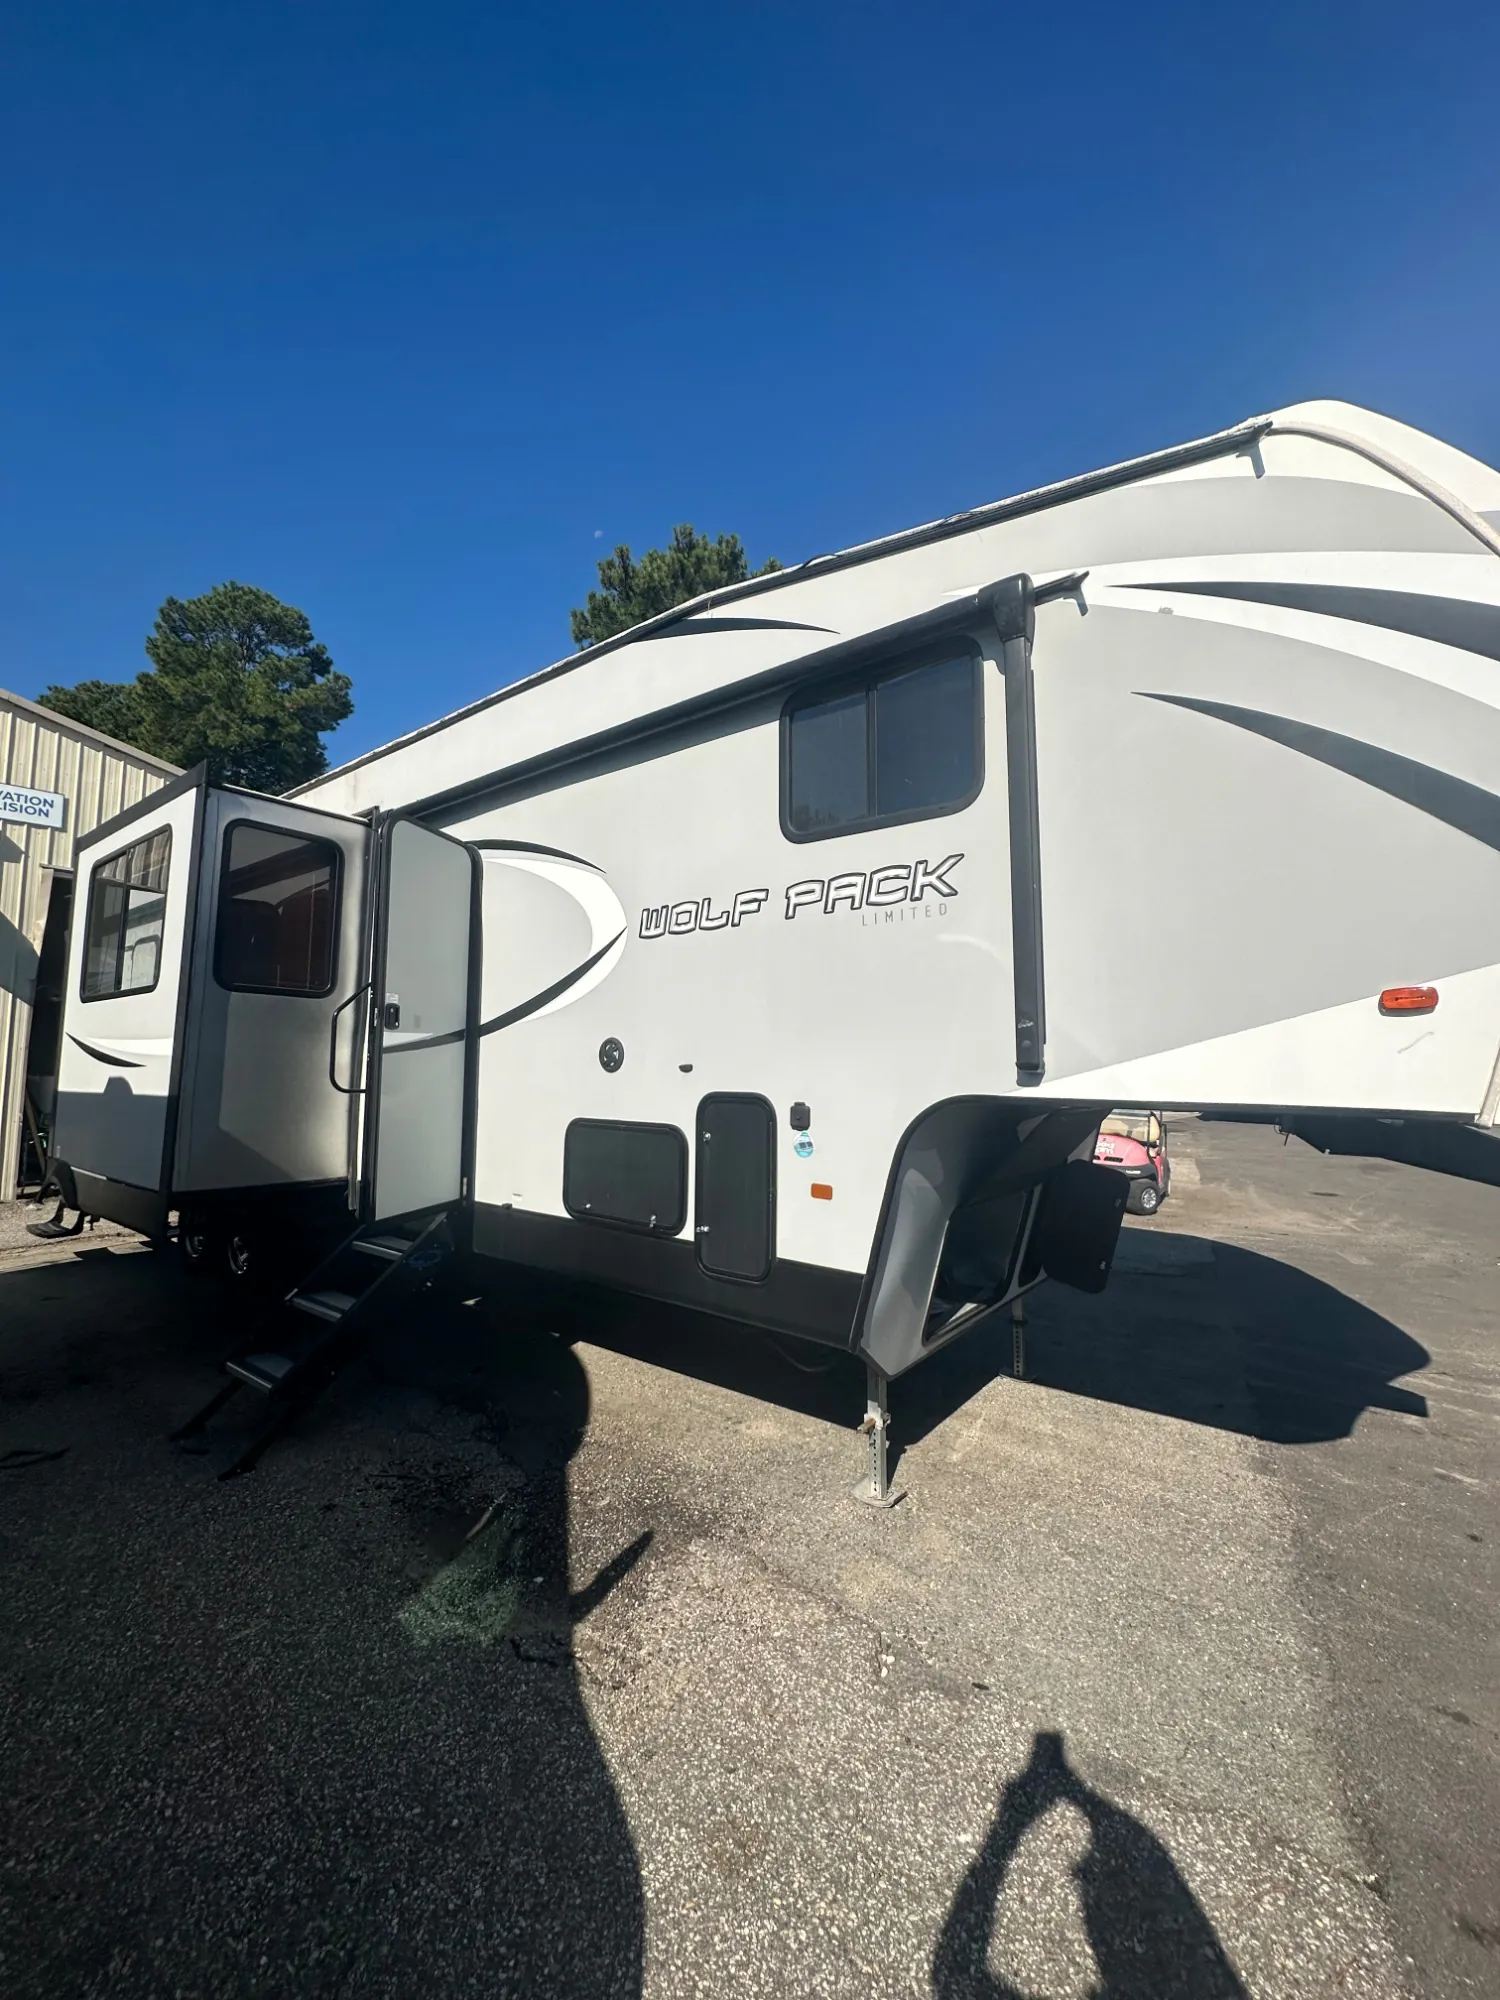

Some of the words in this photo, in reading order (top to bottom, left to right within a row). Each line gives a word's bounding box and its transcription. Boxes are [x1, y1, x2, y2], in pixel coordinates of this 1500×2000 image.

[0, 801, 49, 818] ISION
[639, 888, 769, 939] WOLF
[784, 853, 965, 920] PACK
[862, 903, 948, 926] LIMITED
